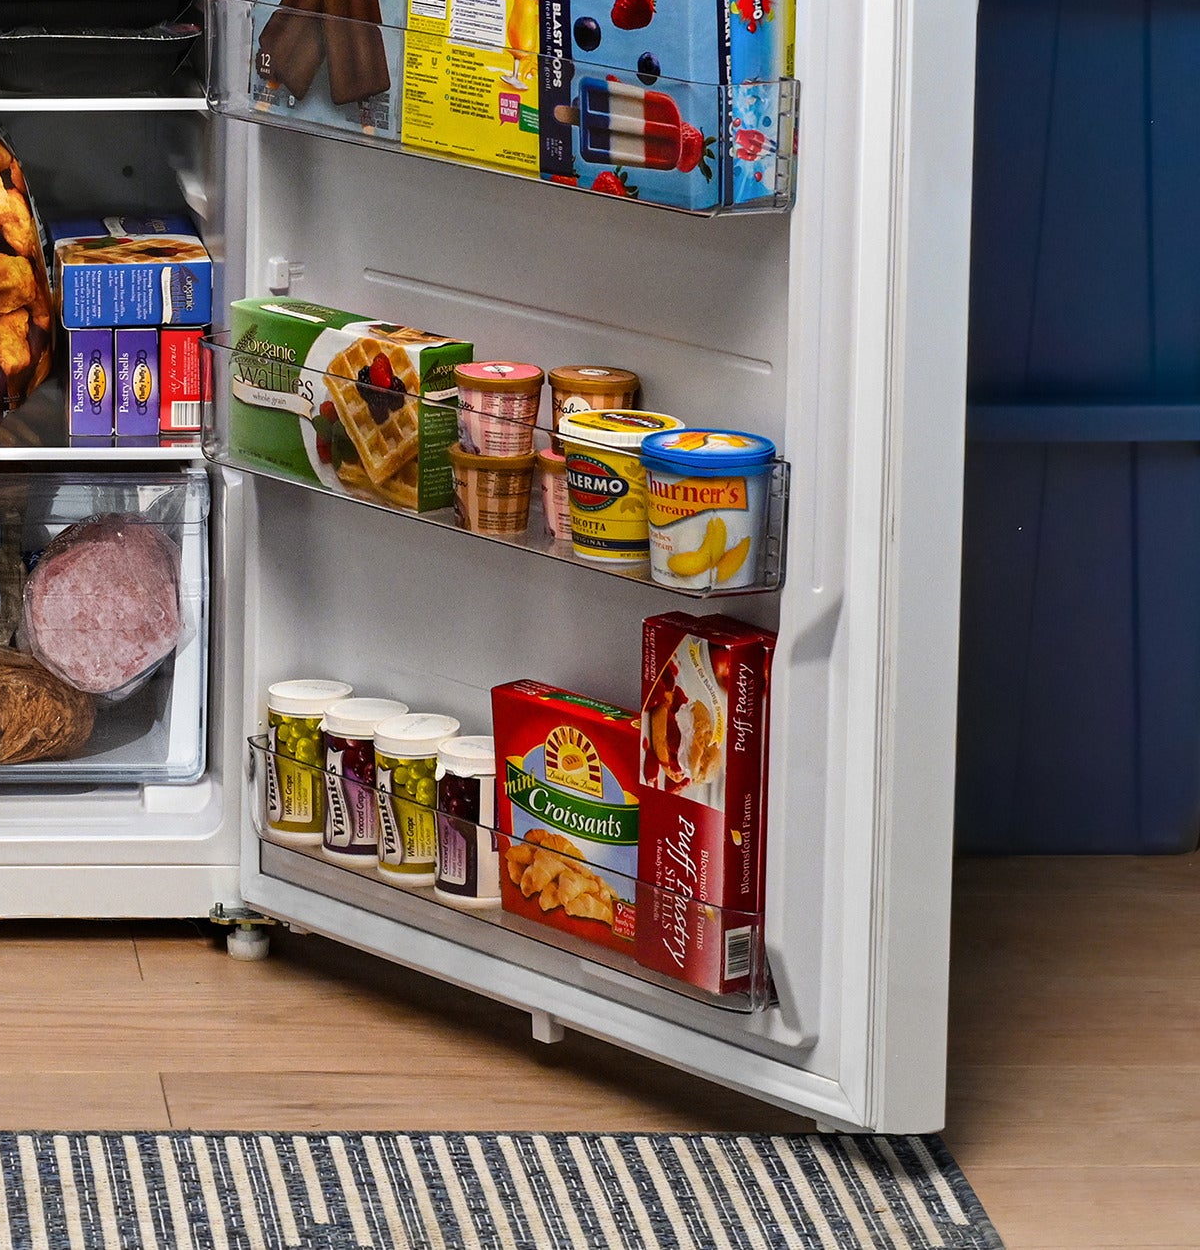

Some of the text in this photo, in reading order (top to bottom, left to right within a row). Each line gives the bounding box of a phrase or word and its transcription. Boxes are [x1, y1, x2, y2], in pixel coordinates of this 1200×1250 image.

[552, 2, 562, 47] BLAST
[260, 53, 271, 67] 12
[552, 49, 563, 88] POPS
[184, 275, 194, 312] organic
[247, 338, 297, 365] organic
[73, 351, 87, 413] Pastry Shells
[119, 351, 132, 413] Pastry Shells
[252, 392, 287, 406] whole grain
[732, 663, 754, 752] Puff Pastry
[285, 774, 294, 795] Grape
[503, 767, 537, 795] mini
[356, 810, 365, 839] Concord
[407, 816, 416, 837] Grape
[528, 787, 622, 838] Croissants
[740, 792, 752, 896] Bloomsford Farms
[662, 814, 698, 969] Puff Pastry
[662, 865, 676, 931] SHELLS
[696, 913, 706, 950] Farms
